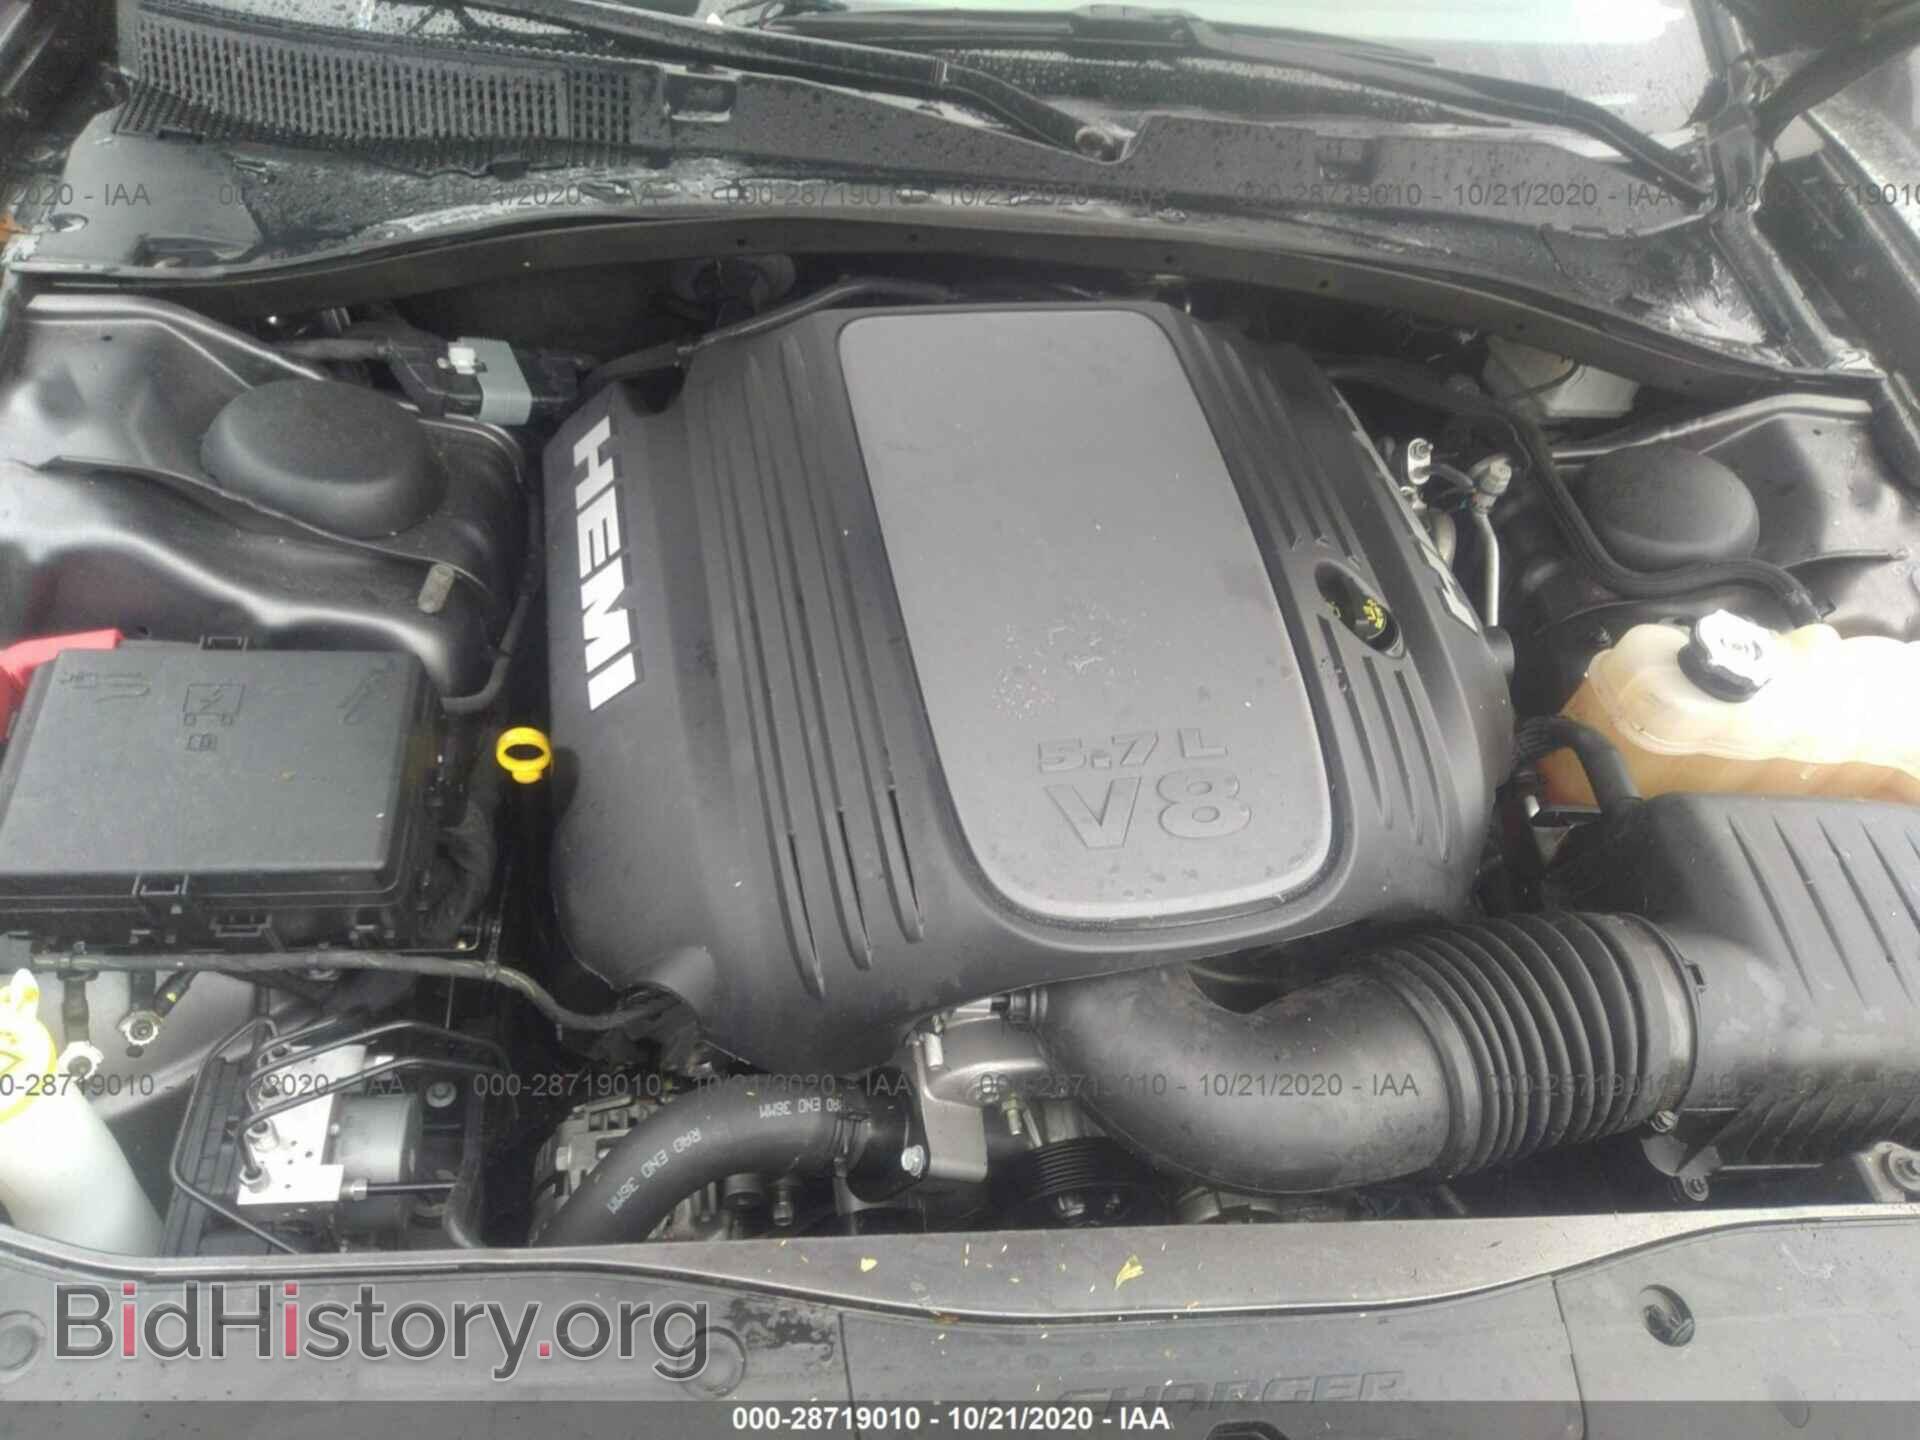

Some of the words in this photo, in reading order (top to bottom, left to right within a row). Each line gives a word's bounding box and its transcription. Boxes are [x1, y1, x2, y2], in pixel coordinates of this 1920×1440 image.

[573, 415, 636, 711] HEMI
[1042, 766, 1252, 850] V8
[641, 1150, 669, 1179] END
[672, 1128, 703, 1153] RAD
